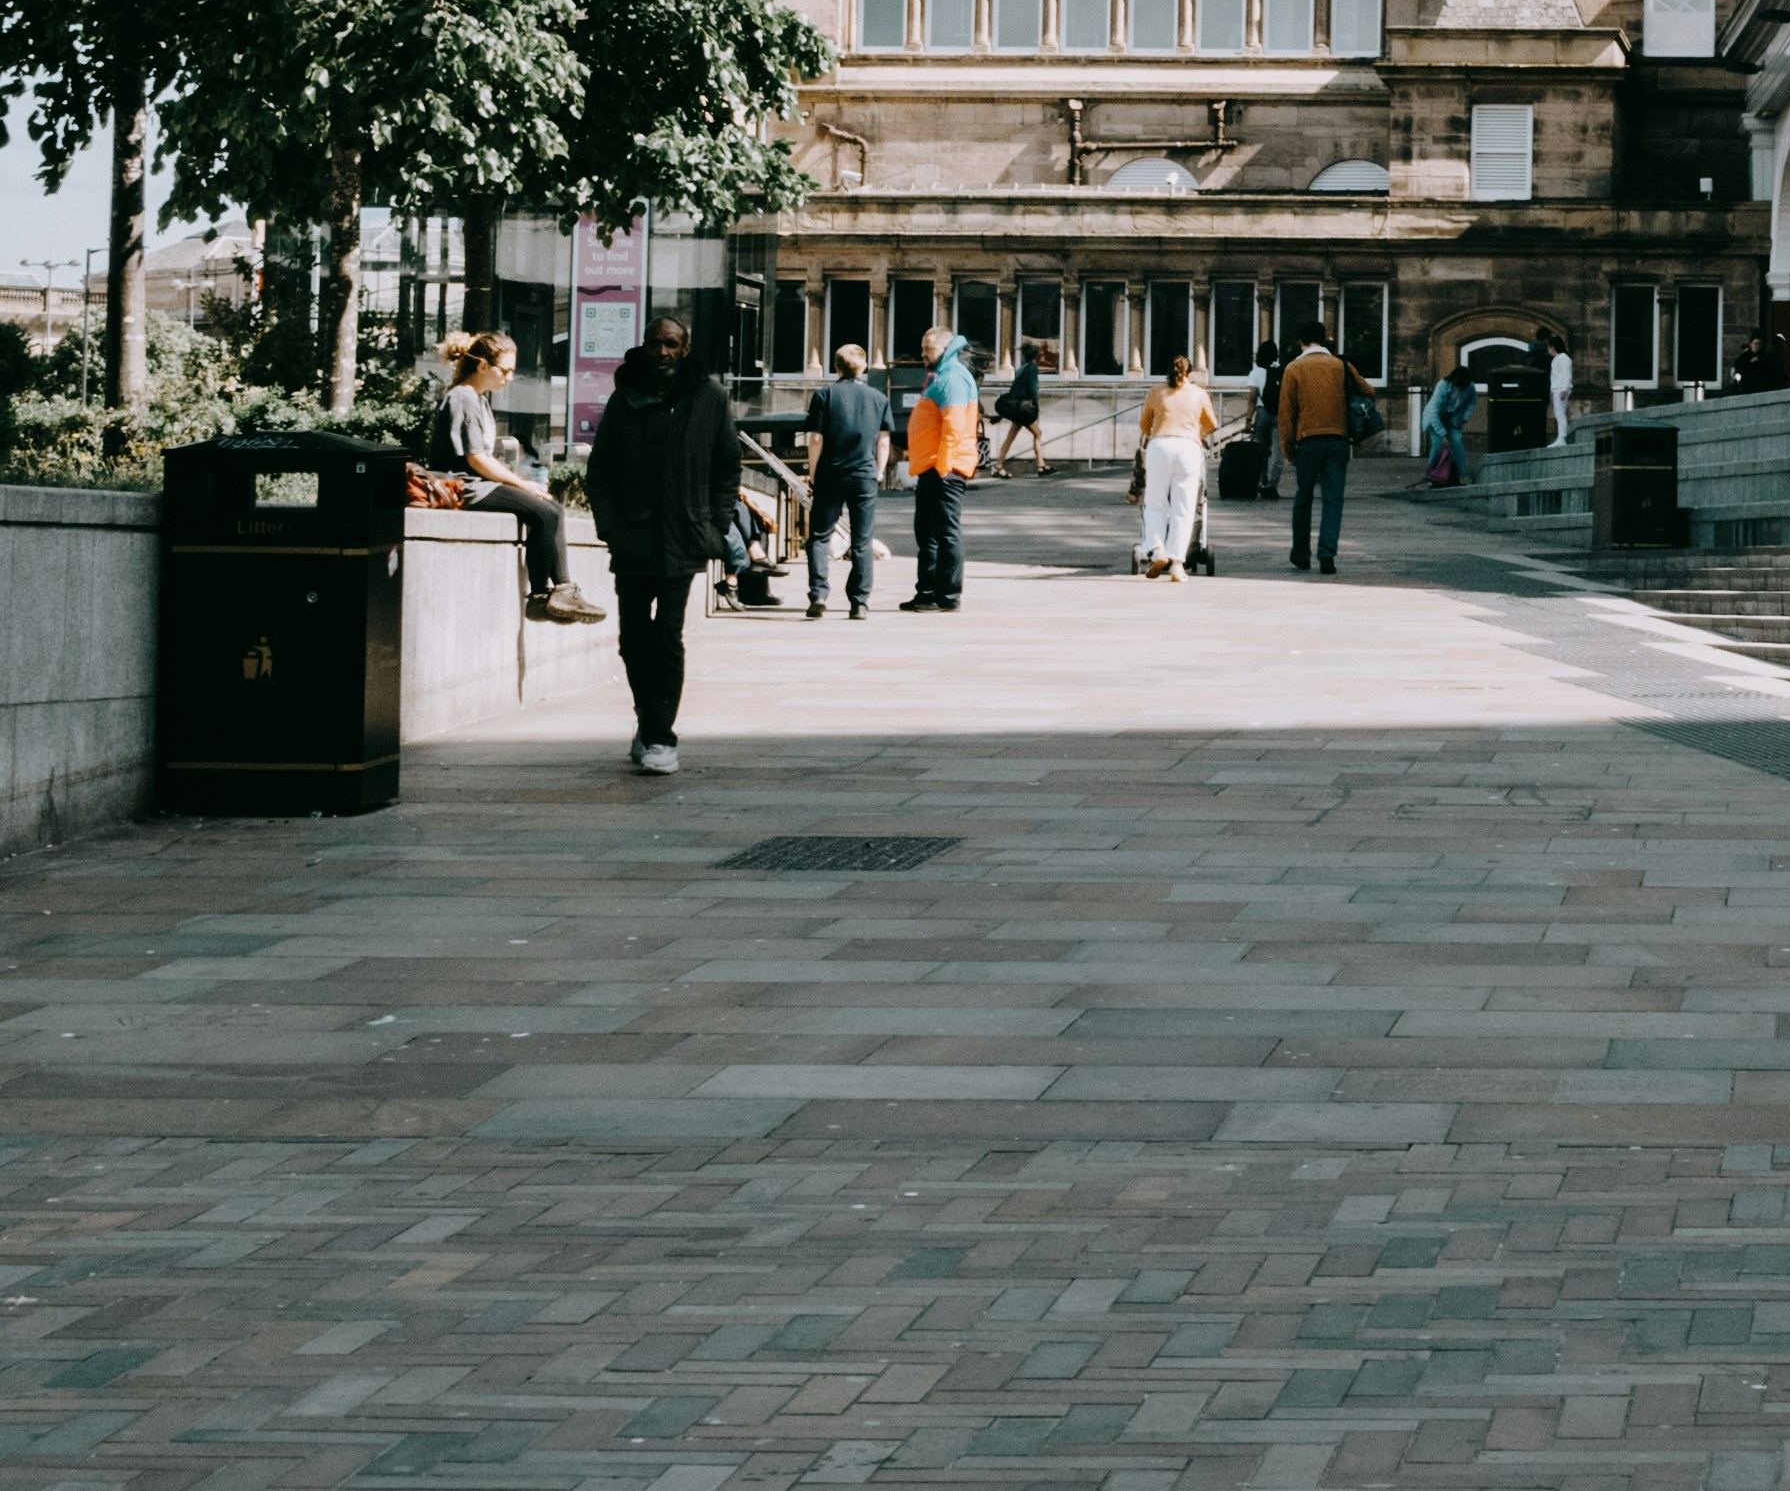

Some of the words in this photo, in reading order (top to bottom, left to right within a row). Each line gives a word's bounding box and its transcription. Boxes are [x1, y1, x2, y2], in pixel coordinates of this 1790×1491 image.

[617, 238, 634, 248] me
[592, 251, 604, 261] to
[607, 250, 629, 261] find
[584, 265, 603, 275] out
[606, 267, 635, 275] more
[237, 519, 285, 534] Litter
